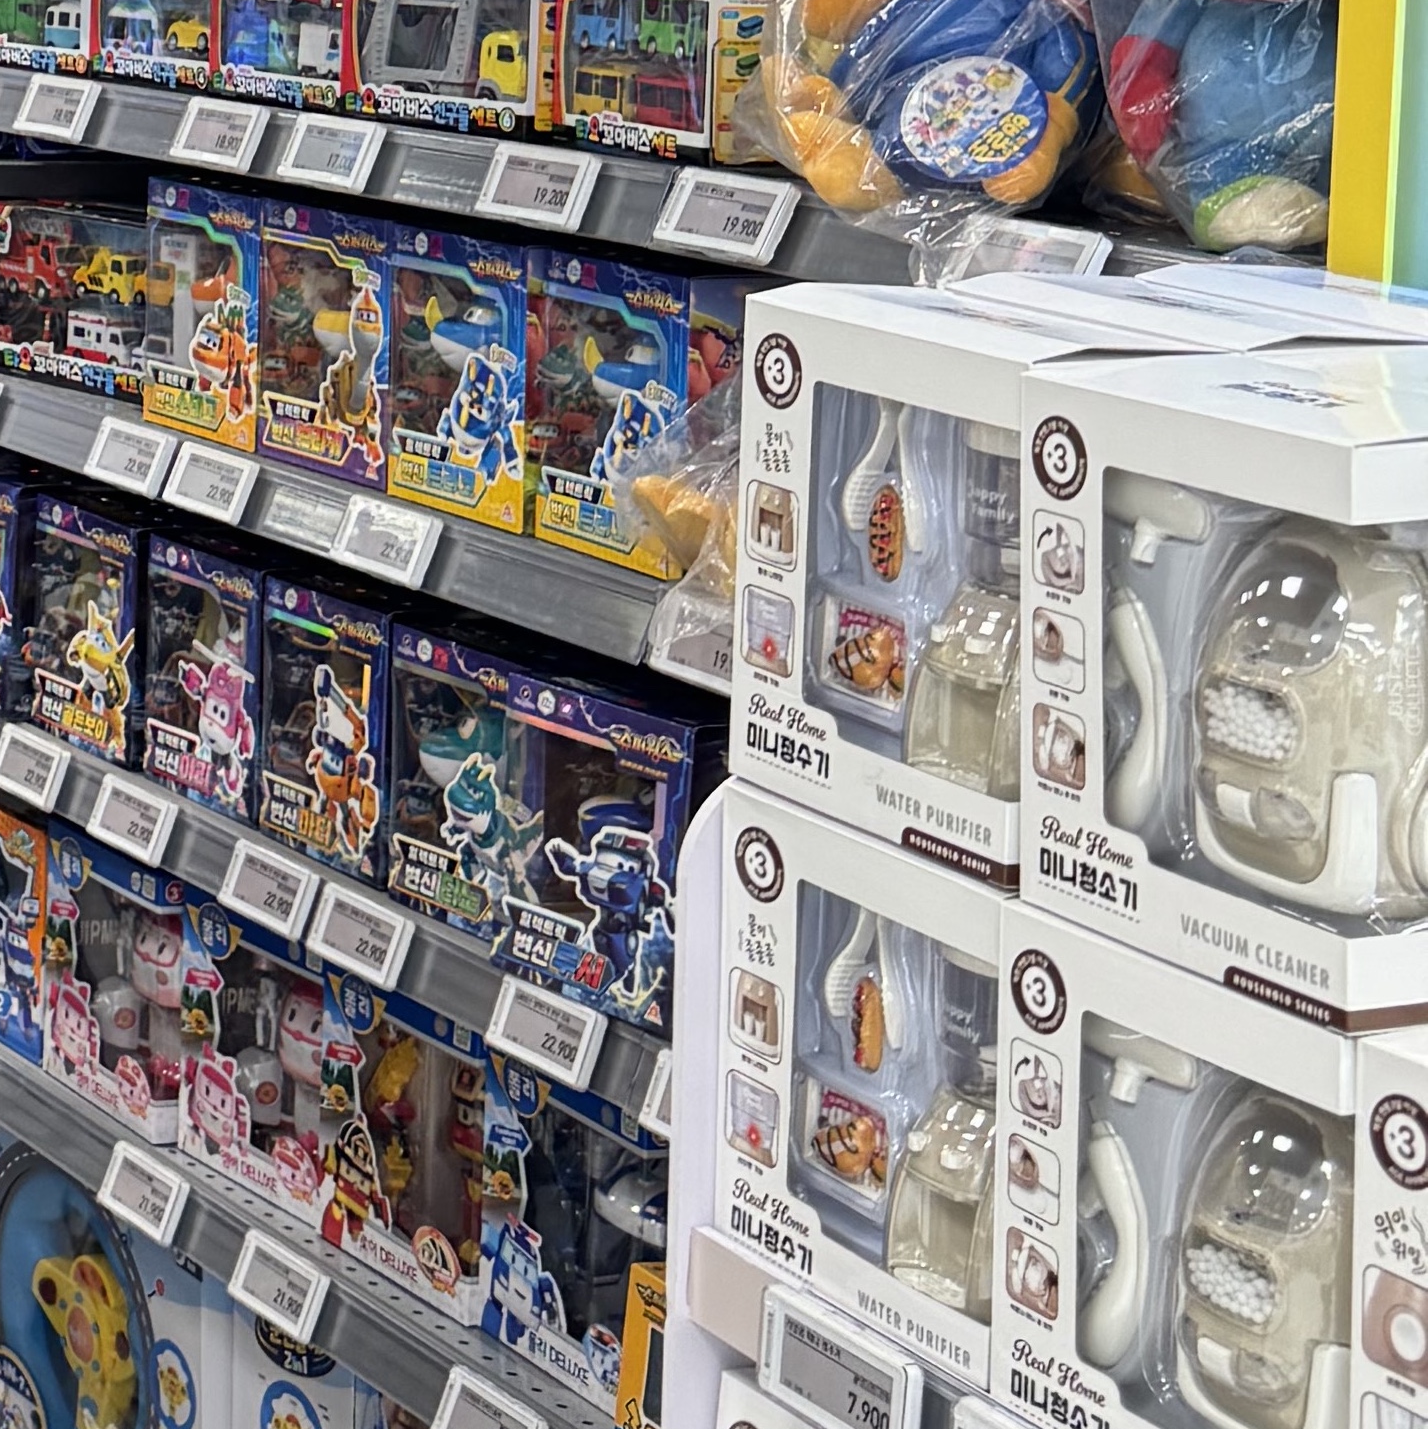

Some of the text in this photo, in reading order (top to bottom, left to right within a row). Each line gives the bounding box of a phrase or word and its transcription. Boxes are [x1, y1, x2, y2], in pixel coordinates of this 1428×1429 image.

[344, 86, 376, 114] 타요
[377, 91, 433, 124] 꼬마버스
[575, 115, 601, 141] 타요
[601, 120, 651, 153] 꼬마버스
[746, 692, 829, 744] Real Home
[745, 721, 832, 781] 미니정수기
[875, 781, 994, 847] WATER PURIFIER
[1040, 815, 1135, 874] Real Home
[1039, 848, 1138, 912] 미니청소기
[512, 929, 553, 967] 변신
[1180, 912, 1331, 992] VACUUM CLEANER
[732, 1177, 810, 1240] Real Home
[730, 1210, 813, 1276] 미니정수기
[857, 1289, 901, 1334] WATER
[905, 1311, 971, 1370] PURIFIER
[1012, 1338, 1107, 1410] Real Home
